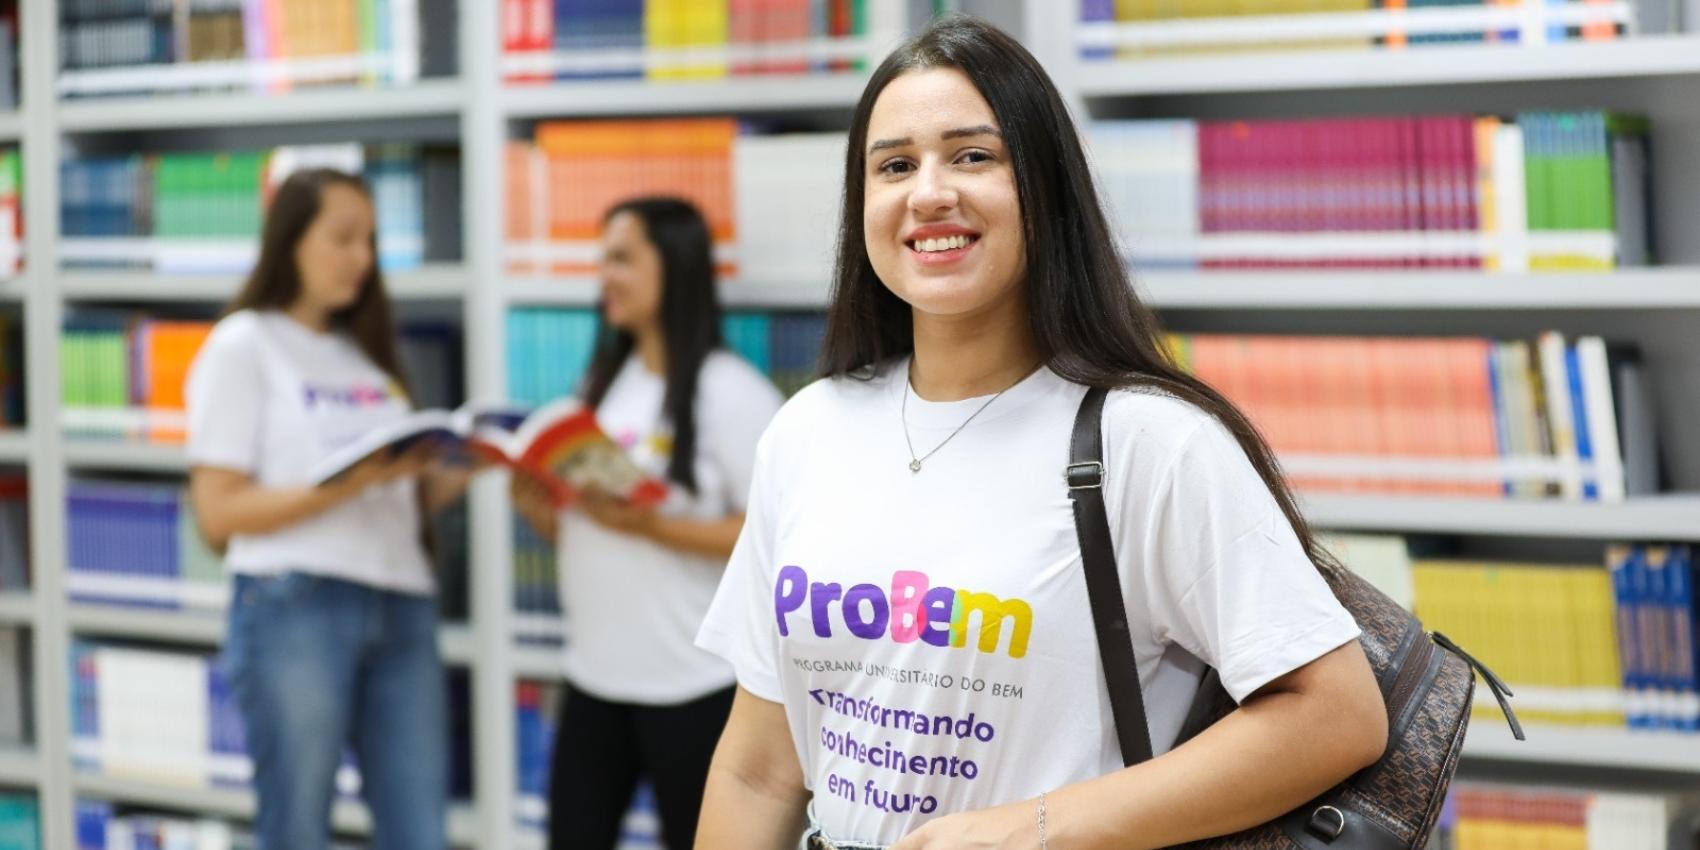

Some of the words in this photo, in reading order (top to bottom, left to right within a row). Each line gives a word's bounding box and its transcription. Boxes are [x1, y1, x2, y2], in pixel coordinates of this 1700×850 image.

[775, 565, 1033, 659] ProBem
[961, 677, 985, 692] DO
[992, 683, 1024, 699] BEM
[828, 773, 856, 803] em
[864, 779, 938, 814] fuuro
